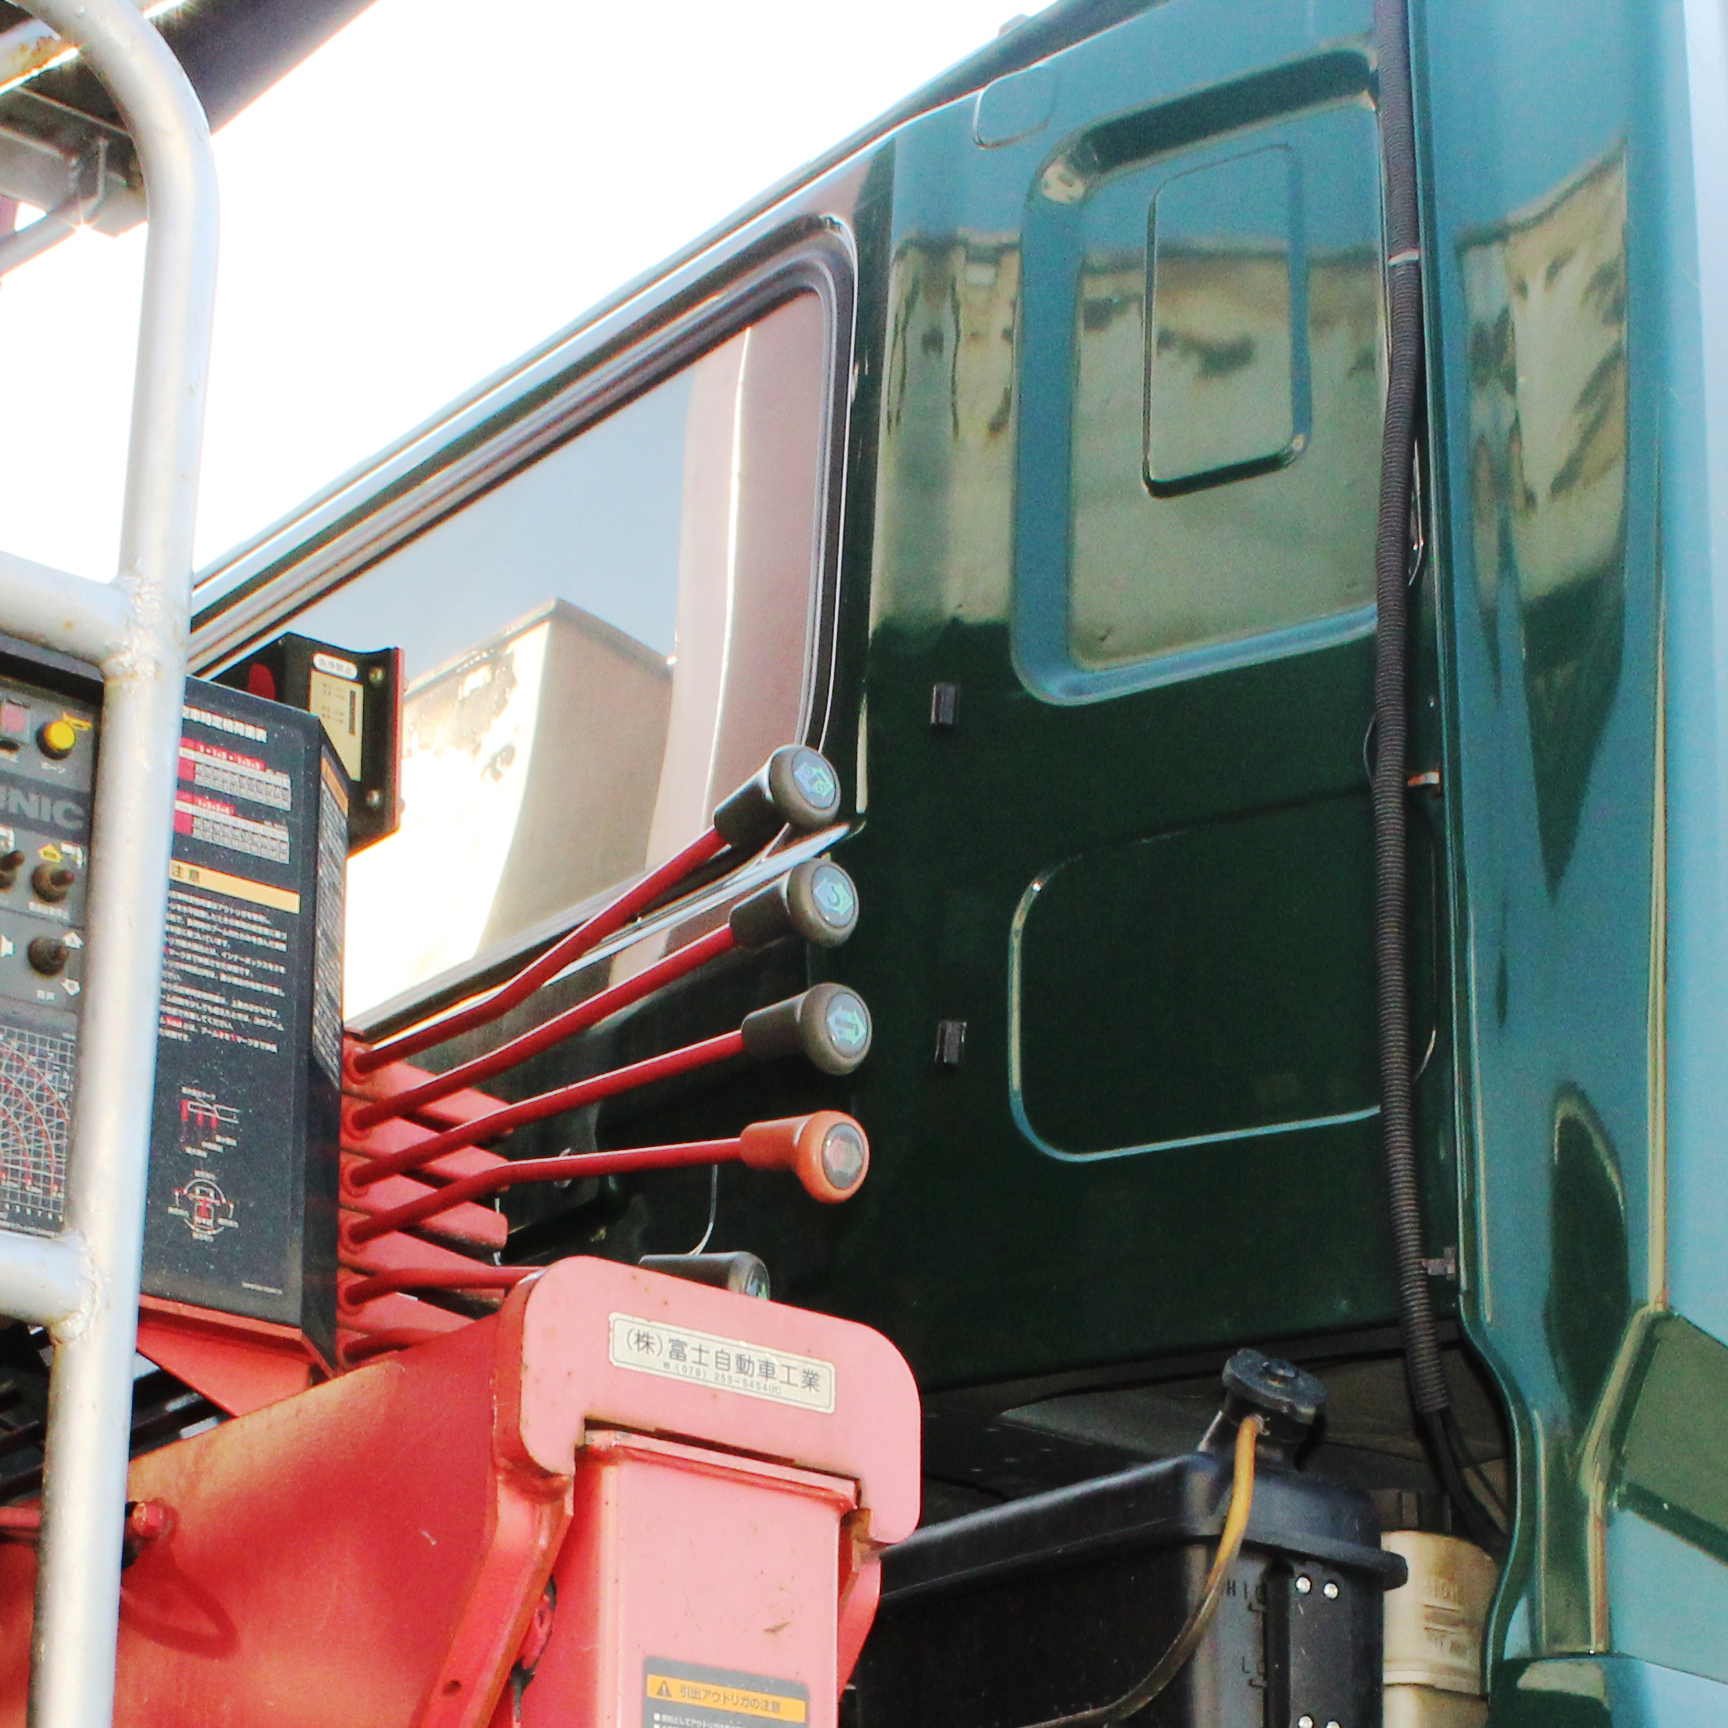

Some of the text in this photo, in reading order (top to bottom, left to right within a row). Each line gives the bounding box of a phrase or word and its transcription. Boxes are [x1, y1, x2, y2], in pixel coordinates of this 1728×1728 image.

[170, 863, 201, 883] 注意
[625, 1326, 822, 1394] (株)富士自動車工業
[679, 1684, 782, 1714] 引出アウトリガの注意
